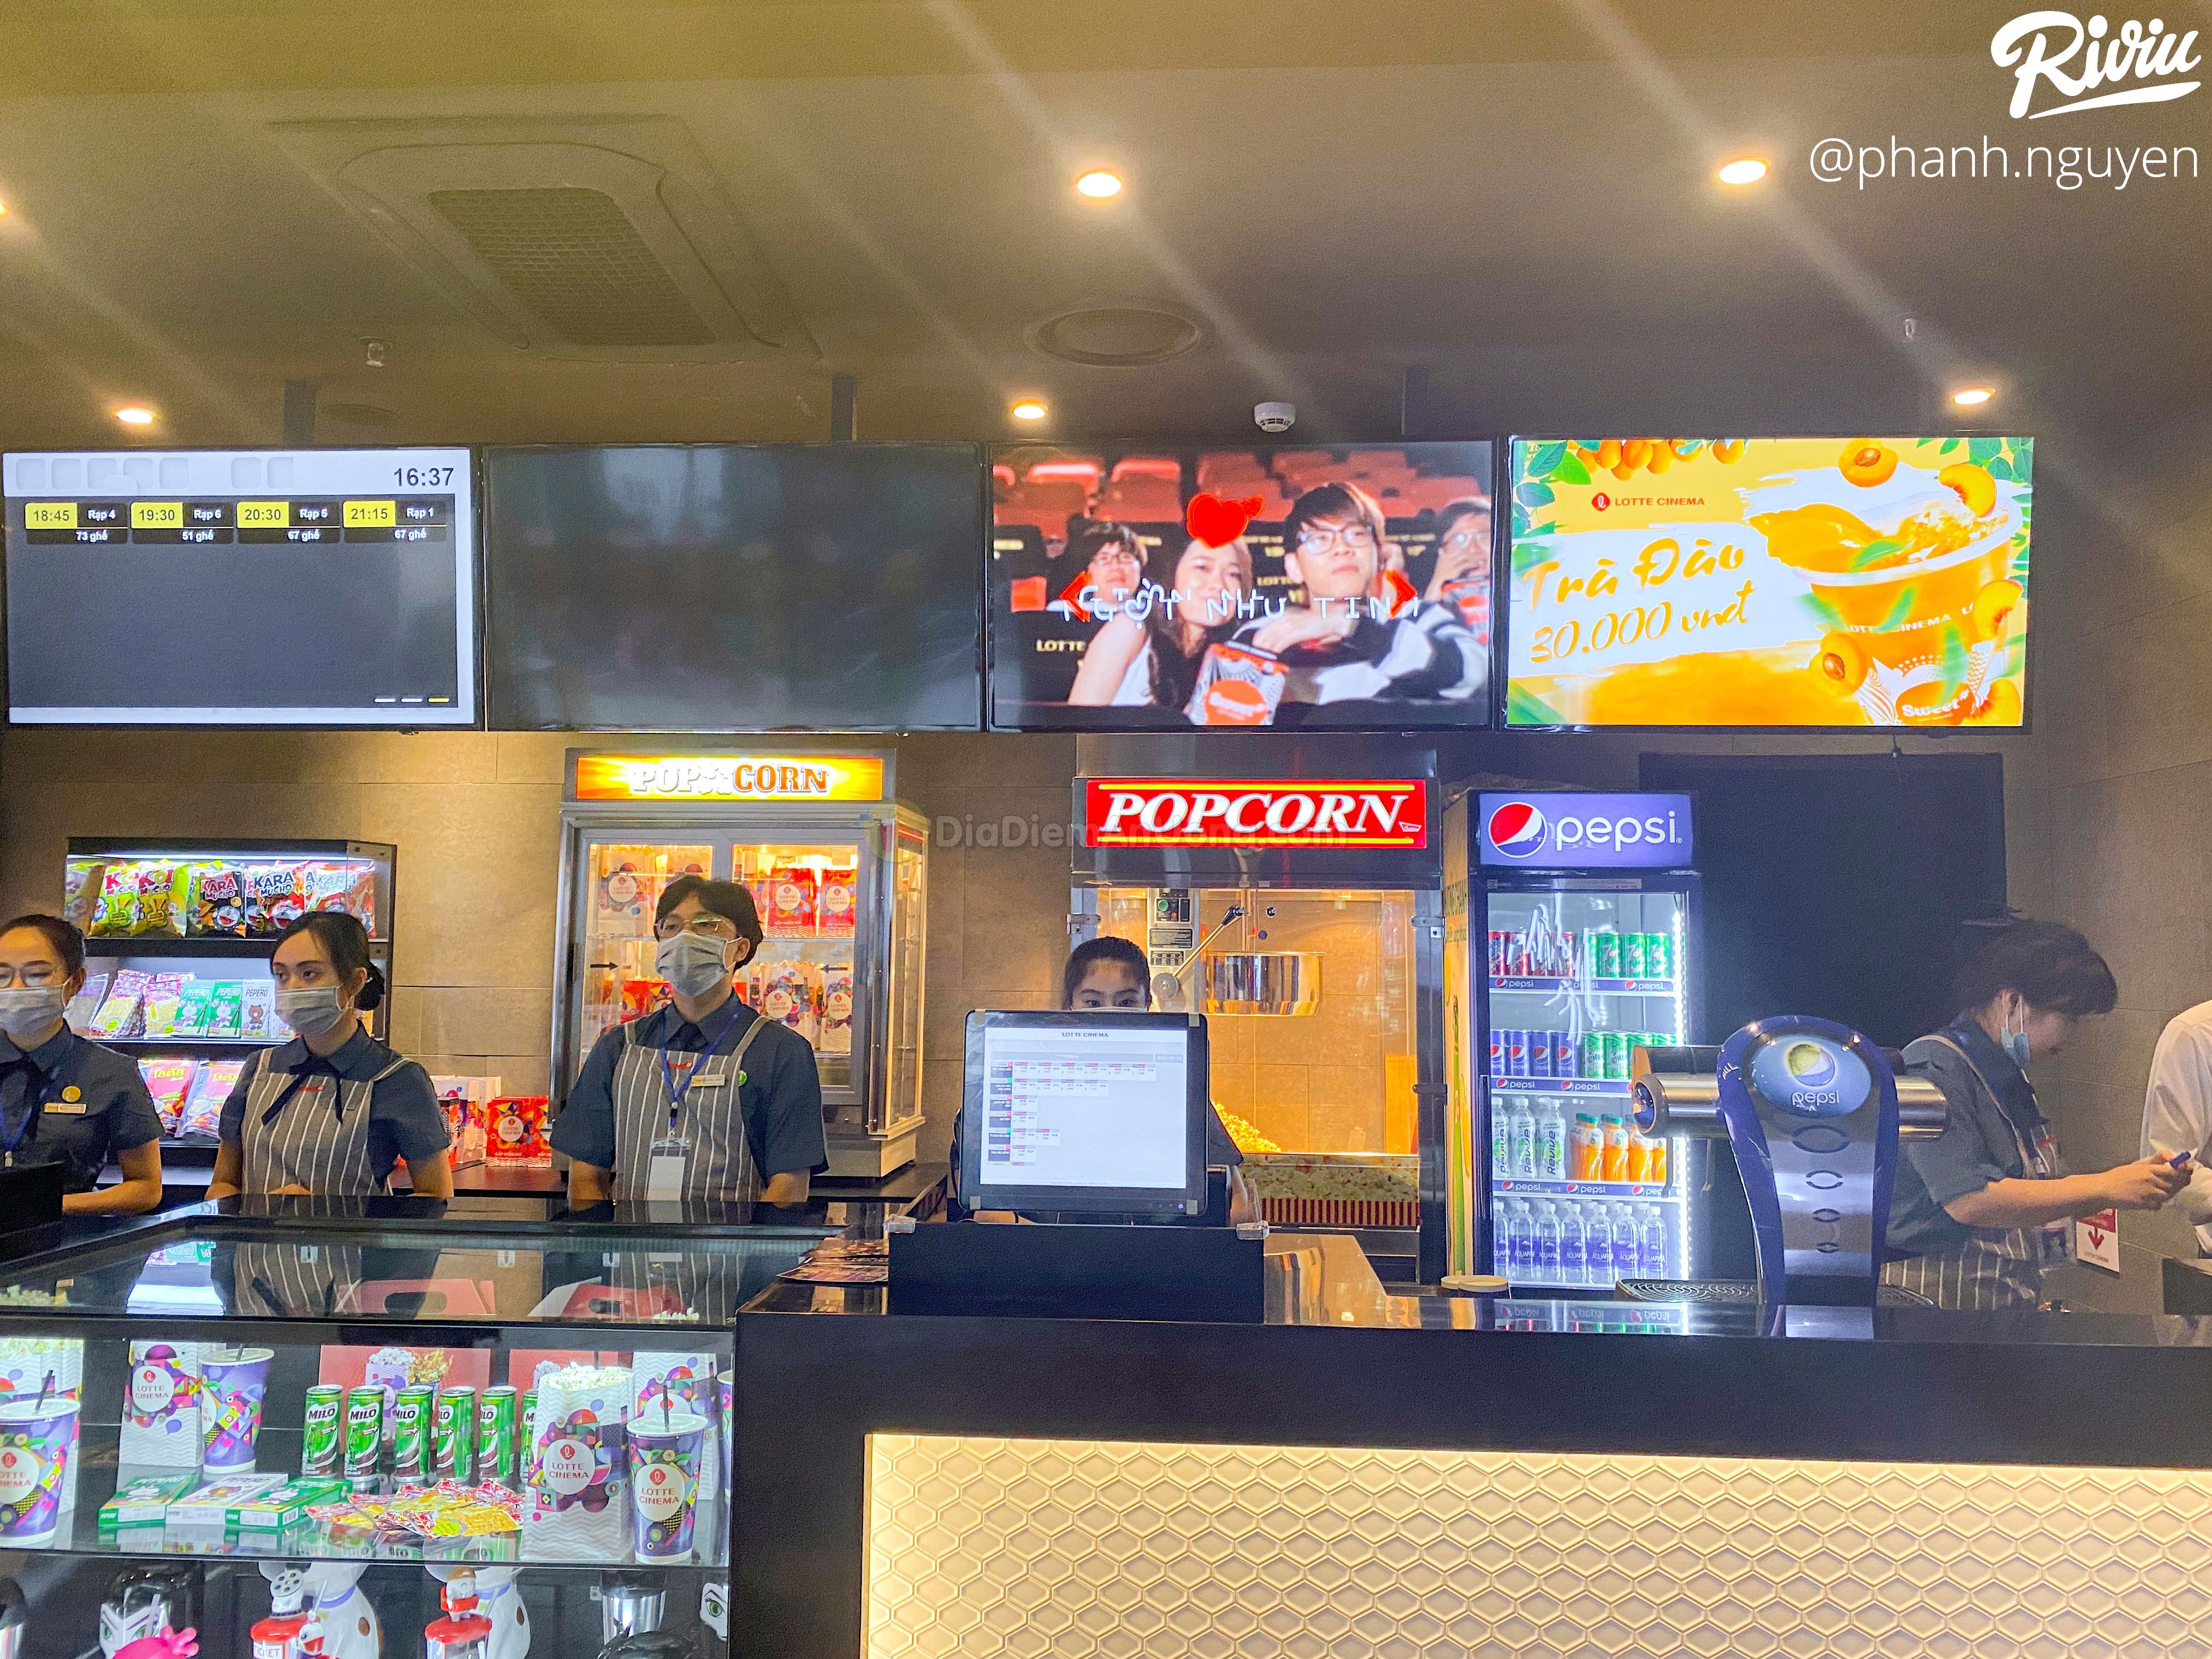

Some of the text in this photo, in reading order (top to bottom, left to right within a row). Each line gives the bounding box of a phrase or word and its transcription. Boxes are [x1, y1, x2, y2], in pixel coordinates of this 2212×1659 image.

[393, 467, 454, 486] 16:37
[1615, 497, 1705, 506] LOTTE CINEMA
[33, 509, 116, 522] 18:45 Rạp 4
[139, 509, 222, 521] 19:30 Rạp 6
[245, 508, 328, 521] 20:30 Rạp 5
[351, 507, 434, 520] 21:15 Rạp 1
[76, 531, 88, 541] 73
[182, 531, 194, 540] 51
[287, 531, 299, 540] 67
[394, 530, 407, 539] 67
[1522, 537, 1745, 610] Trà Đào
[1895, 614, 1951, 633] INEMA
[1530, 601, 1672, 663] 30.000
[633, 764, 829, 793] POP CORN
[1098, 793, 1409, 834] POPCORN
[1555, 810, 1678, 851] pepsi
[254, 870, 295, 889] KARA
[261, 883, 293, 897] MUCHO
[1509, 980, 1534, 989] pepsi
[1573, 980, 1599, 990] psi
[1638, 981, 1664, 990] pepsi
[184, 988, 209, 996] PEPERO
[217, 988, 240, 996] PEPERO
[246, 989, 268, 997] PEPERO
[1509, 1081, 1534, 1089] pepsi
[1575, 1082, 1600, 1091] pepsi
[1791, 1090, 1839, 1106] pepsi
[1547, 1130, 1556, 1175] Revive
[1515, 1183, 1541, 1192] pepsi
[1580, 1185, 1606, 1194] pepsi
[308, 1408, 335, 1420] MILO
[349, 1408, 376, 1420] MILO
[549, 1471, 589, 1479] CINEMA
[639, 1497, 680, 1505] CINEMA
